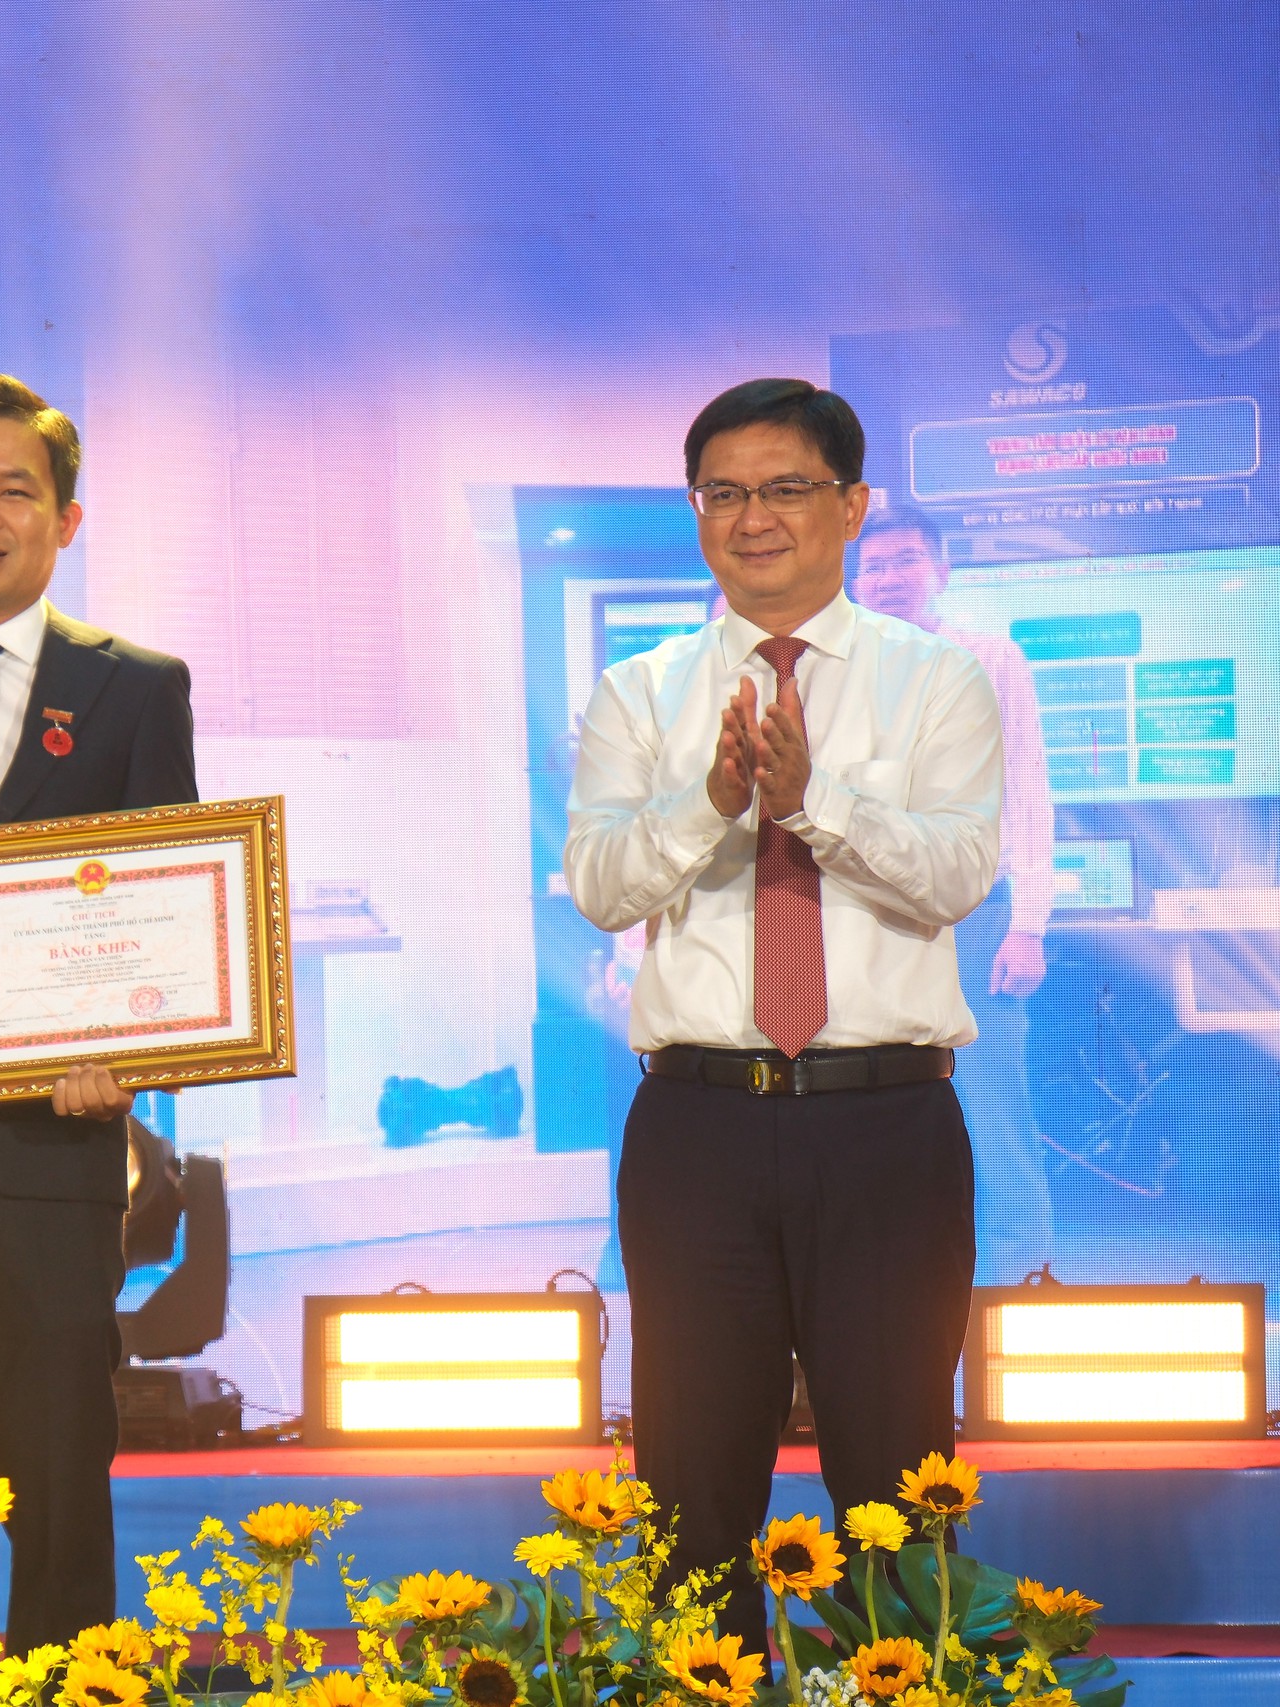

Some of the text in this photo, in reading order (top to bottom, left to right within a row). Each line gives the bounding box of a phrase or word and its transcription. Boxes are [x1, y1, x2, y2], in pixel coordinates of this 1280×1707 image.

[72, 910, 115, 921] CHỦ TỊCH
[49, 939, 141, 960] BẰNG KHEN
